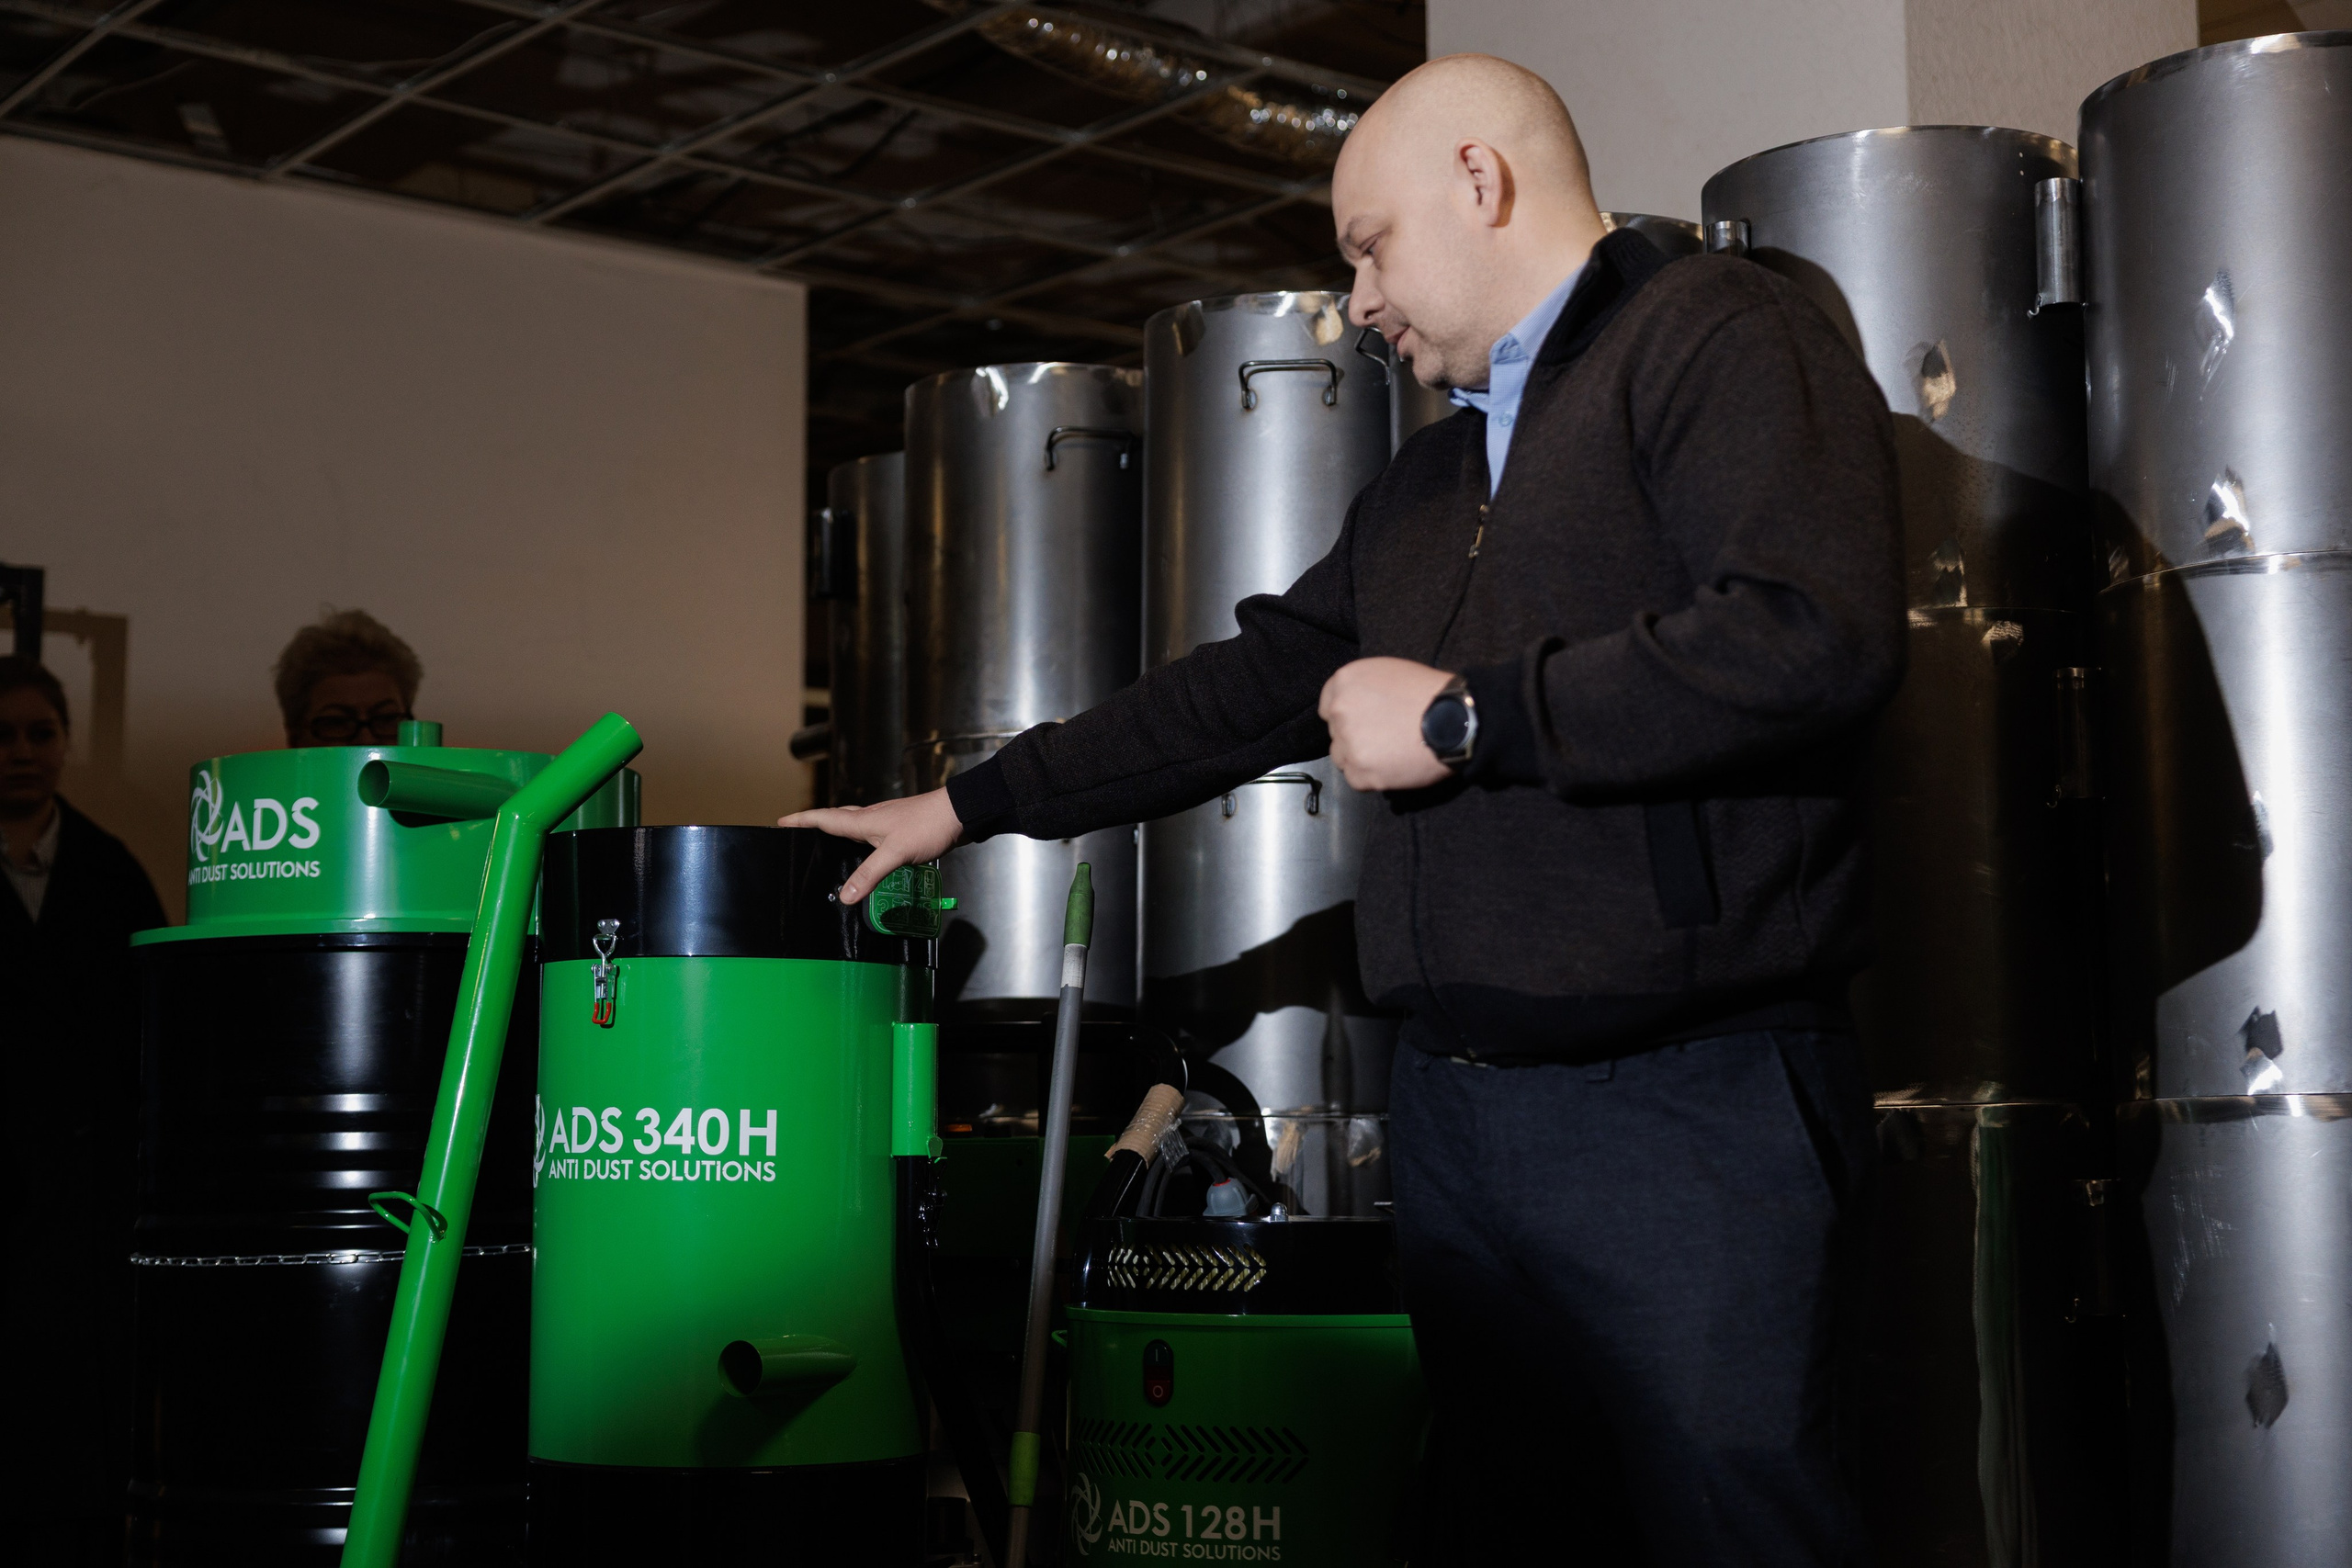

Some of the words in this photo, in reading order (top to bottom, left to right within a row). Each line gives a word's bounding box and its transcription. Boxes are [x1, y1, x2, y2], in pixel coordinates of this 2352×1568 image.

[220, 796, 321, 852] ADS
[188, 867, 200, 886] ANTI
[202, 864, 228, 883] DUST
[230, 861, 321, 880] SOLUTIONS
[548, 1106, 624, 1154] ADS
[633, 1107, 730, 1156] 340
[739, 1109, 777, 1156] H
[548, 1158, 579, 1179] ANTI
[583, 1158, 634, 1181] DUST
[639, 1159, 777, 1182] SOLUTIONS
[1107, 1499, 1171, 1537] ADS
[1181, 1504, 1248, 1540] 128
[1252, 1506, 1281, 1540] H
[1107, 1537, 1136, 1554] ANTI
[1140, 1540, 1179, 1558] DUST
[1182, 1542, 1282, 1561] SOLUTIONS
